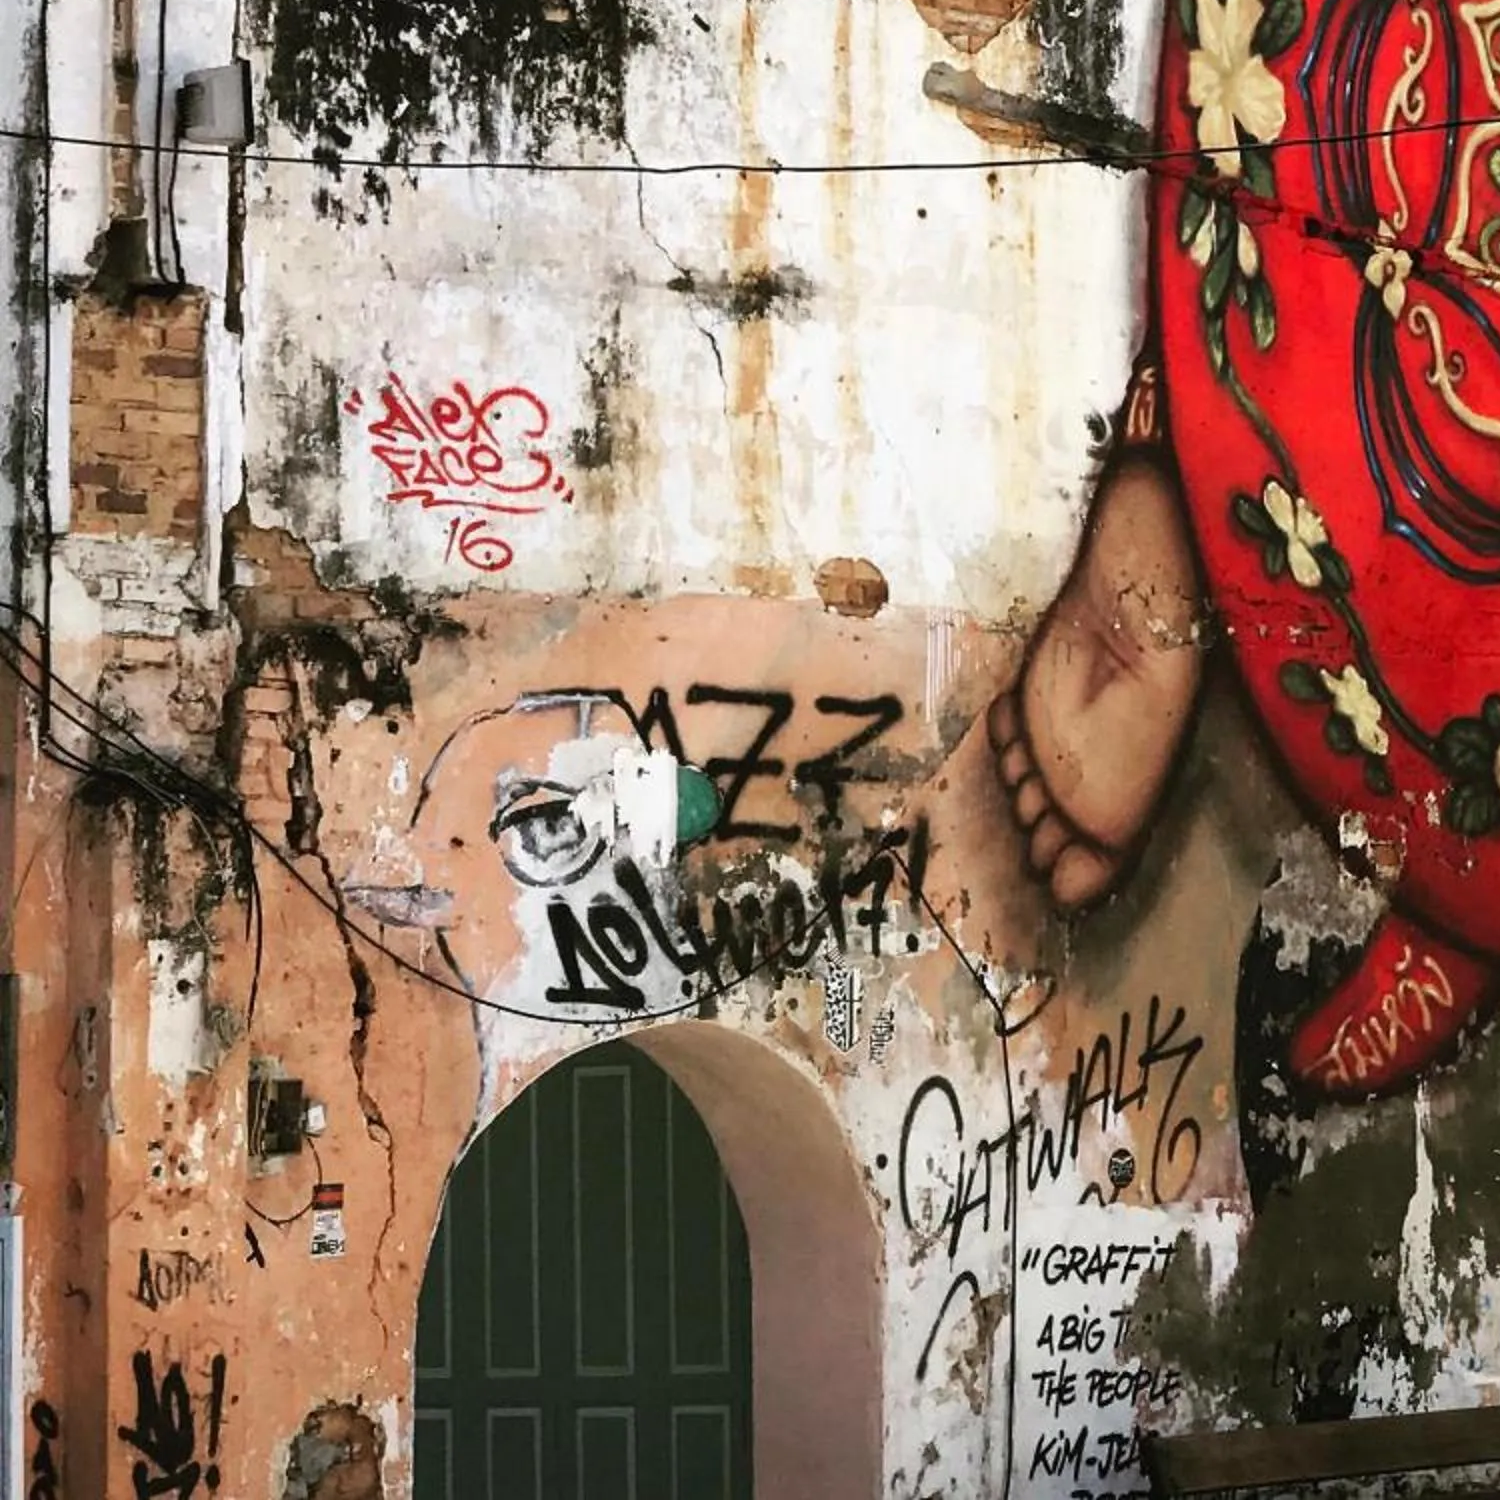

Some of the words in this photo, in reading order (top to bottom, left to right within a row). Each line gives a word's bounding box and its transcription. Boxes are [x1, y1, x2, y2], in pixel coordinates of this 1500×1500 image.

[444, 516, 514, 572] 16
[1037, 1313, 1056, 1357] A
[1031, 1358, 1077, 1419] THE
[1086, 1364, 1182, 1409] PEOPLE
